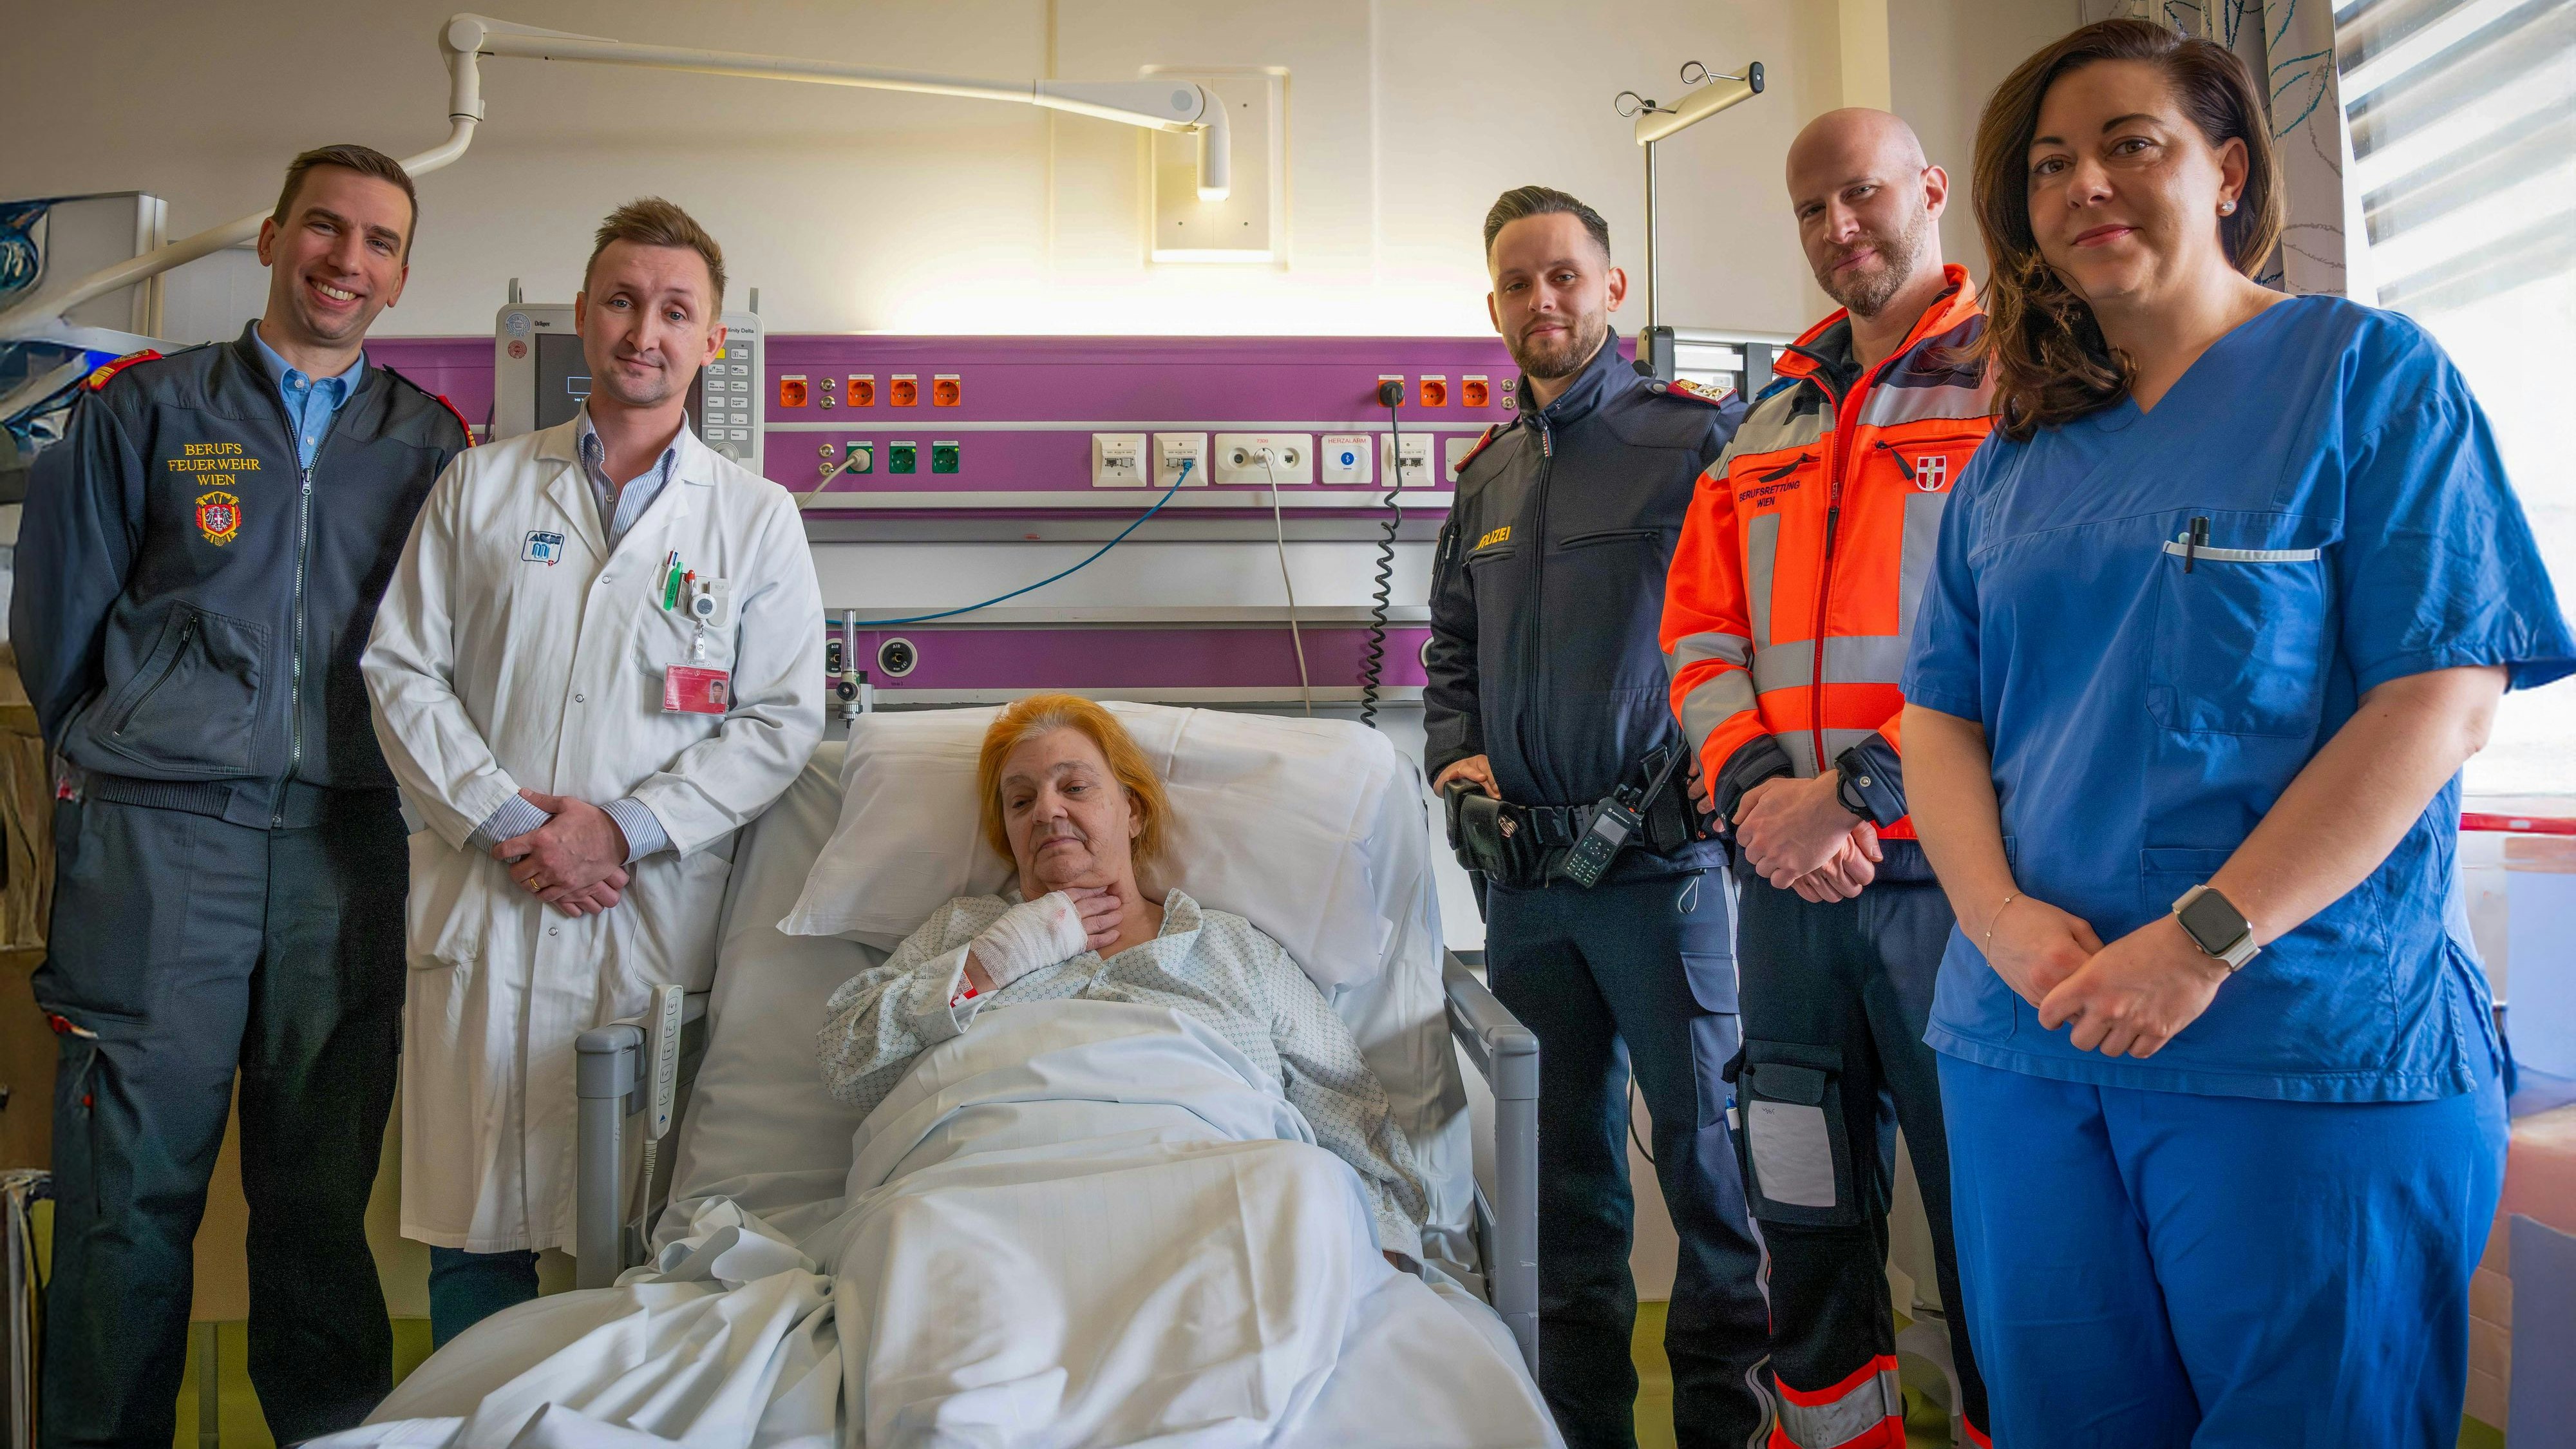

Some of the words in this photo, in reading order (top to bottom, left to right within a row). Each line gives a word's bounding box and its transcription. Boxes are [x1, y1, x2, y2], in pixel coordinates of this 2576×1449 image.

[184, 442, 243, 456] BERUFS
[167, 458, 261, 471] FEUERWEHR
[196, 473, 236, 486] WIEN
[1739, 480, 1801, 503] BERUFSRETTUNG
[1756, 496, 1776, 509] WIEN
